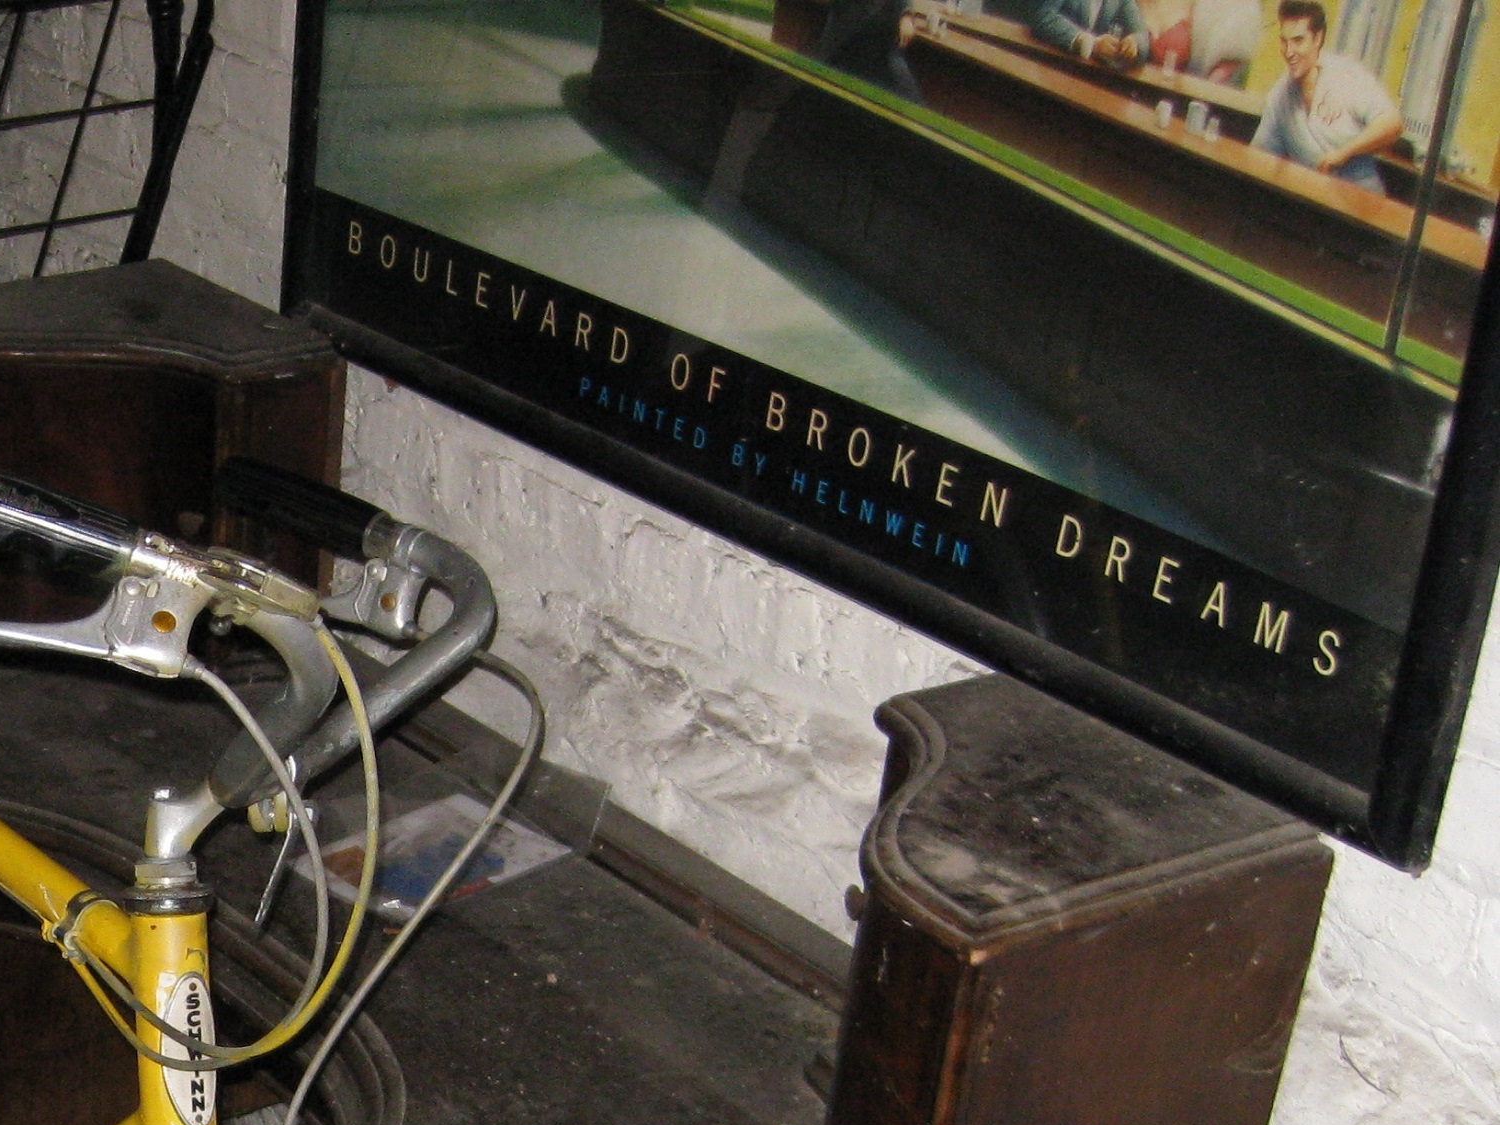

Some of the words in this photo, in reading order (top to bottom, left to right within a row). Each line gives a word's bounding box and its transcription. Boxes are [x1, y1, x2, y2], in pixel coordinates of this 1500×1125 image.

[348, 220, 630, 365] BOULEVARD
[670, 352, 727, 404] OF
[765, 390, 1011, 529] BROKEN
[1054, 513, 1343, 677] DREAMS
[578, 376, 708, 450] PAINTED
[730, 442, 767, 477] BY
[790, 468, 971, 567] HELNWEIN
